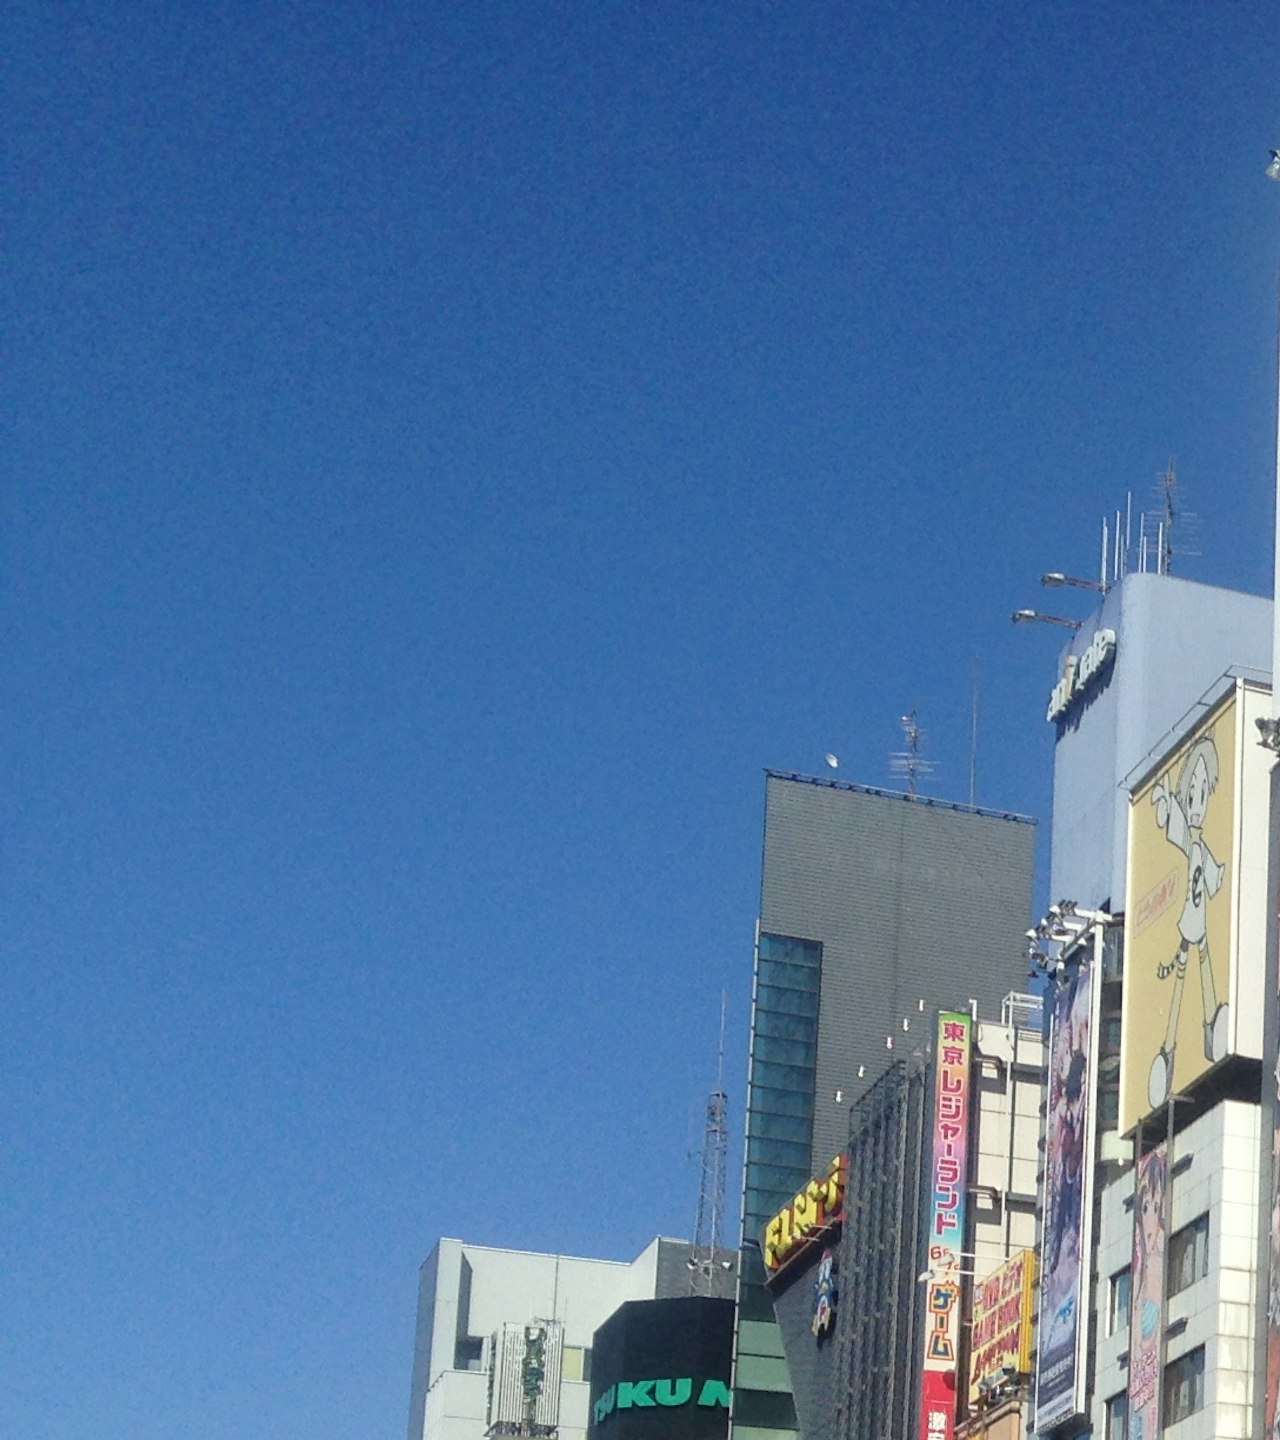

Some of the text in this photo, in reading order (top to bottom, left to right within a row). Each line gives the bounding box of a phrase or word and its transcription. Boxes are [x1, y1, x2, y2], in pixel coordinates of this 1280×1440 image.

[936, 1021, 966, 1236] 東京レジャーランド
